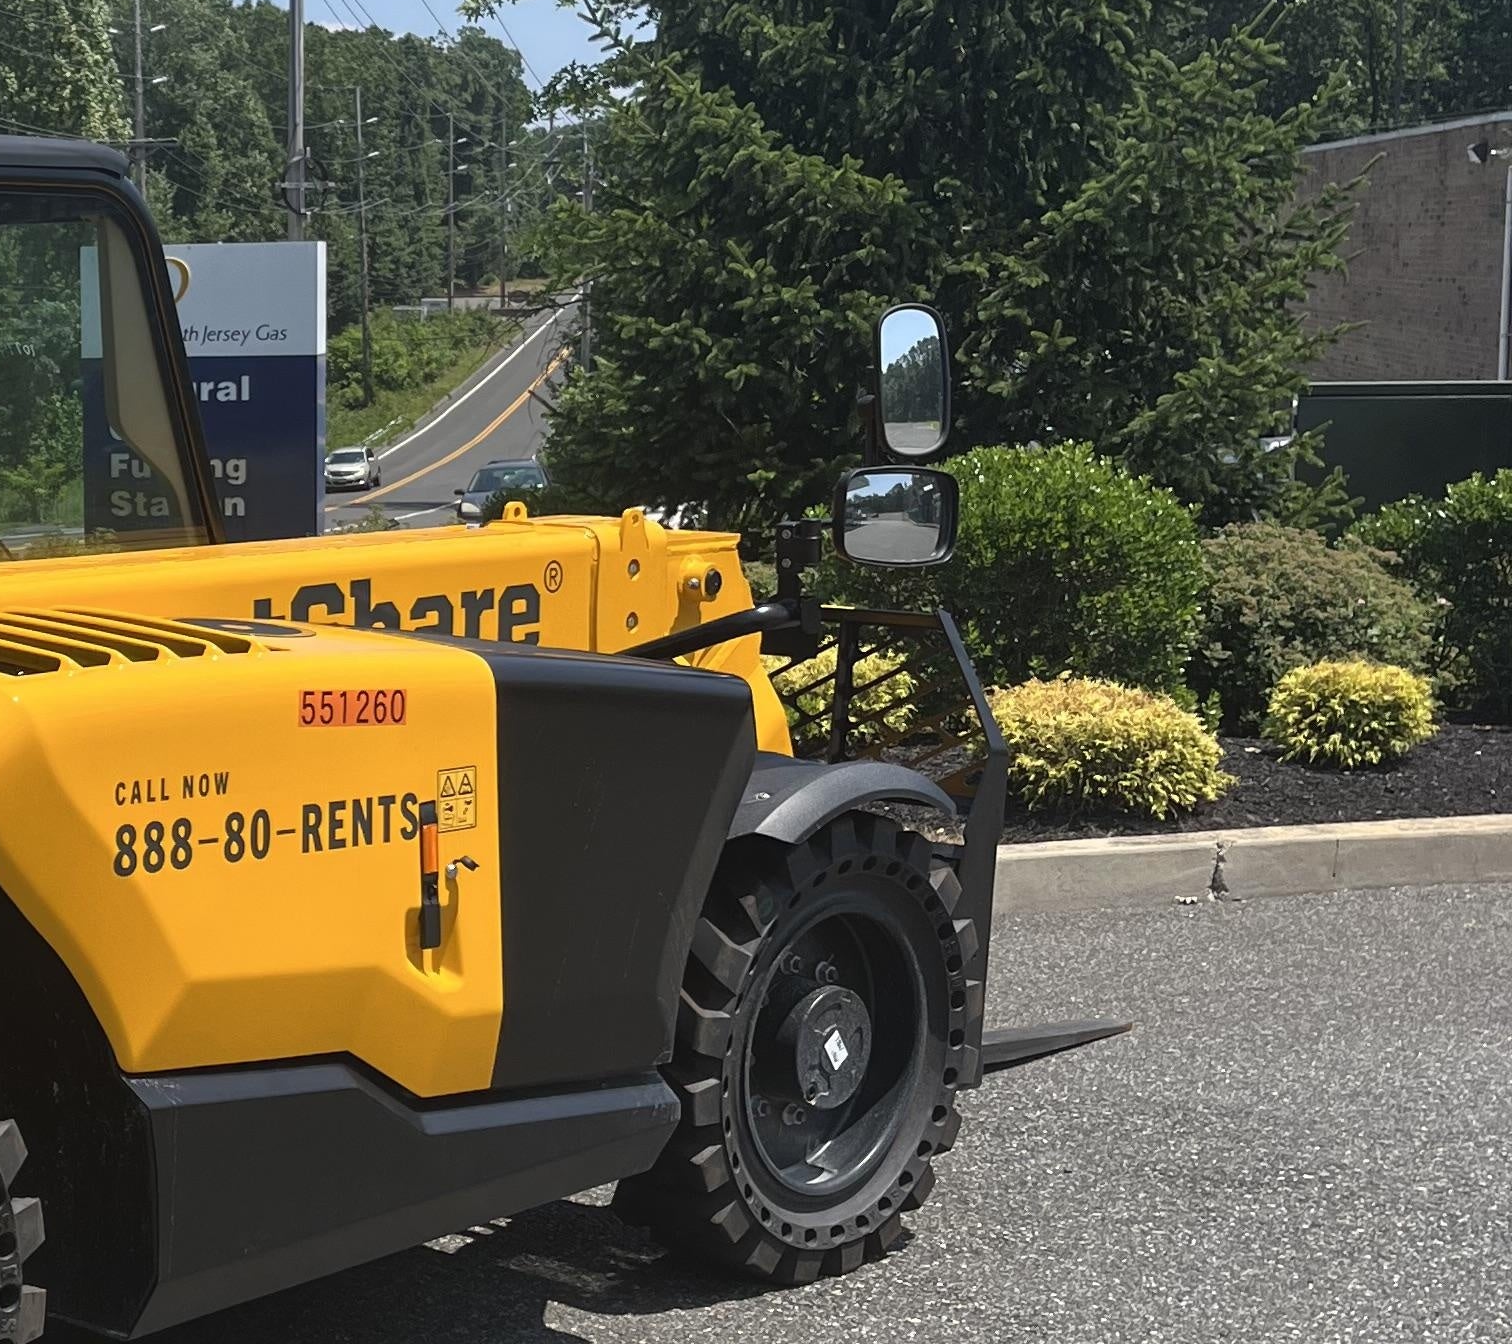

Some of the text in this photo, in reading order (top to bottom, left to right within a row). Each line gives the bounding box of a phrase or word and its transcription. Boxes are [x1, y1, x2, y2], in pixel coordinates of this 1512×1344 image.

[200, 325, 251, 347] Jersey
[255, 324, 289, 342] Gas
[110, 453, 248, 485] Fung
[301, 689, 405, 725] 551260
[114, 771, 231, 806] CALL NOW
[113, 792, 419, 878] 888-80-RENTS
